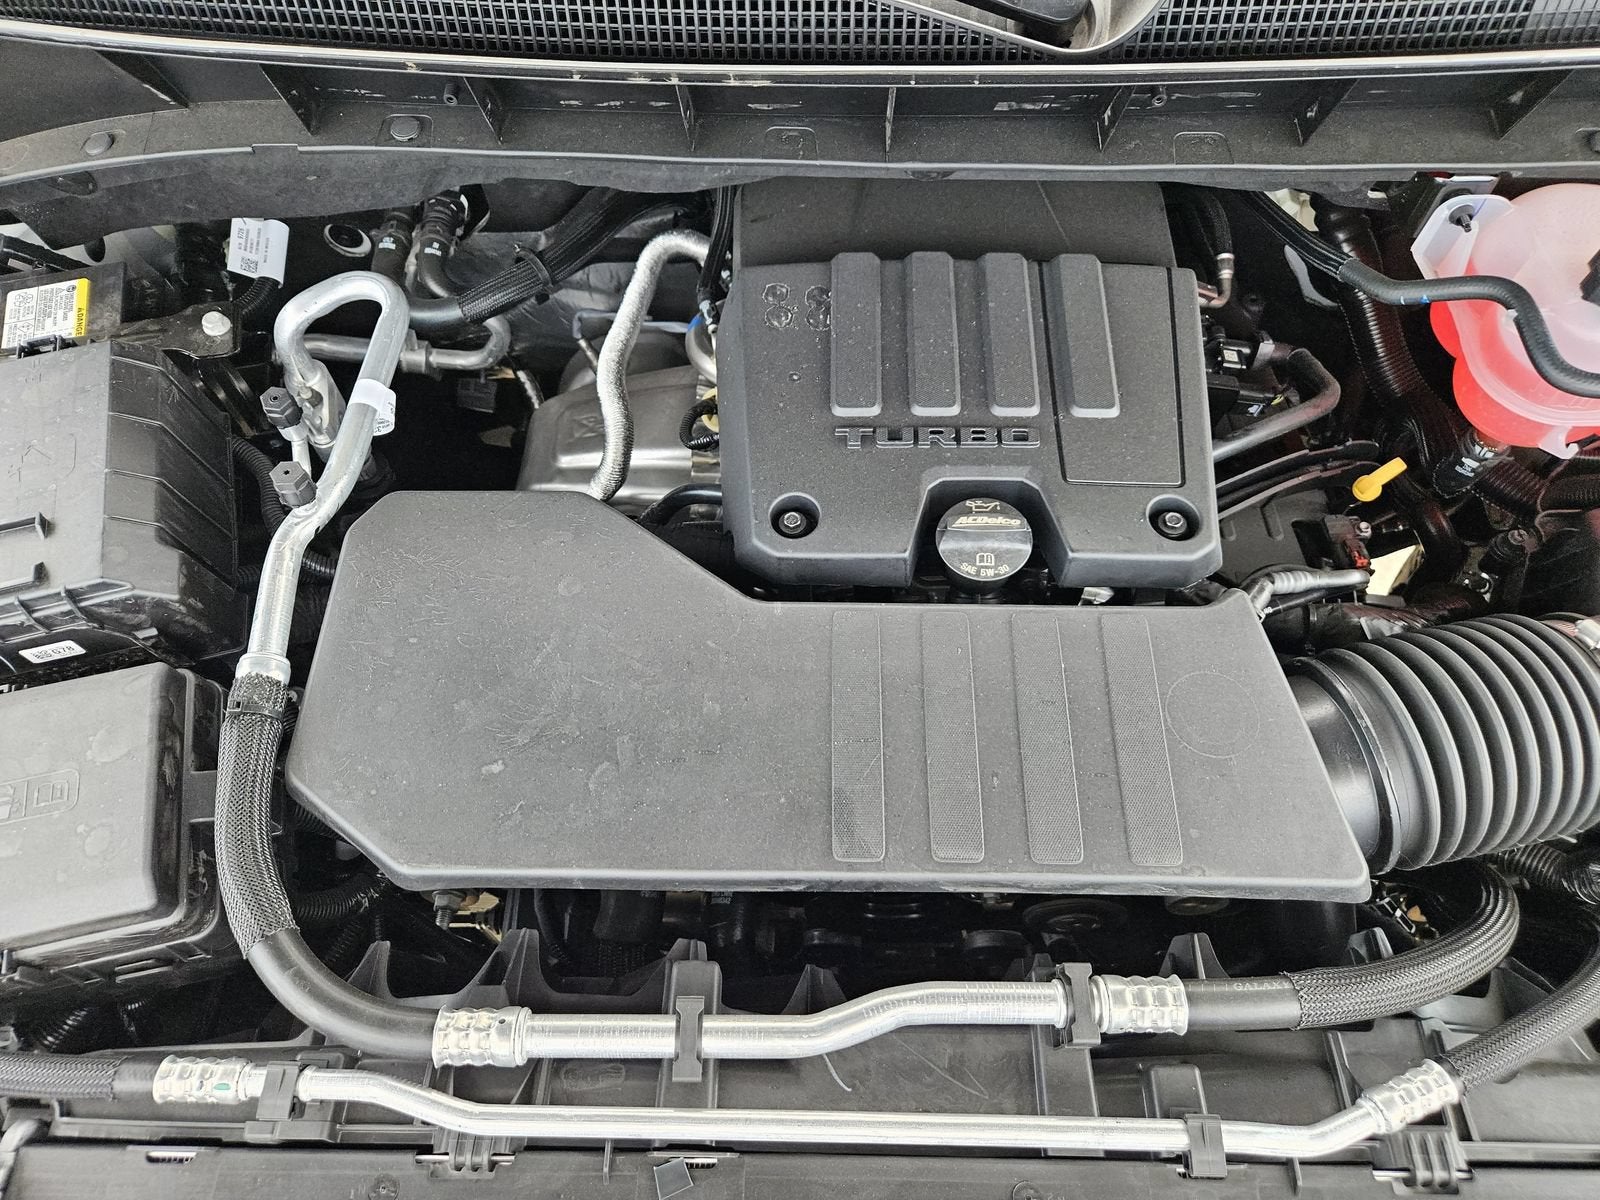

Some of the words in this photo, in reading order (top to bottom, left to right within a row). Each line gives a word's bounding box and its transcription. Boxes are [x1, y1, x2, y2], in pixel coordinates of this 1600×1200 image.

[75, 312, 85, 336] DANGE
[834, 426, 1040, 449] TURBO
[953, 516, 1021, 526] ACDelco
[960, 562, 978, 575] SAE
[980, 564, 1010, 577] 5W-30
[1233, 981, 1291, 991] GALAXY
